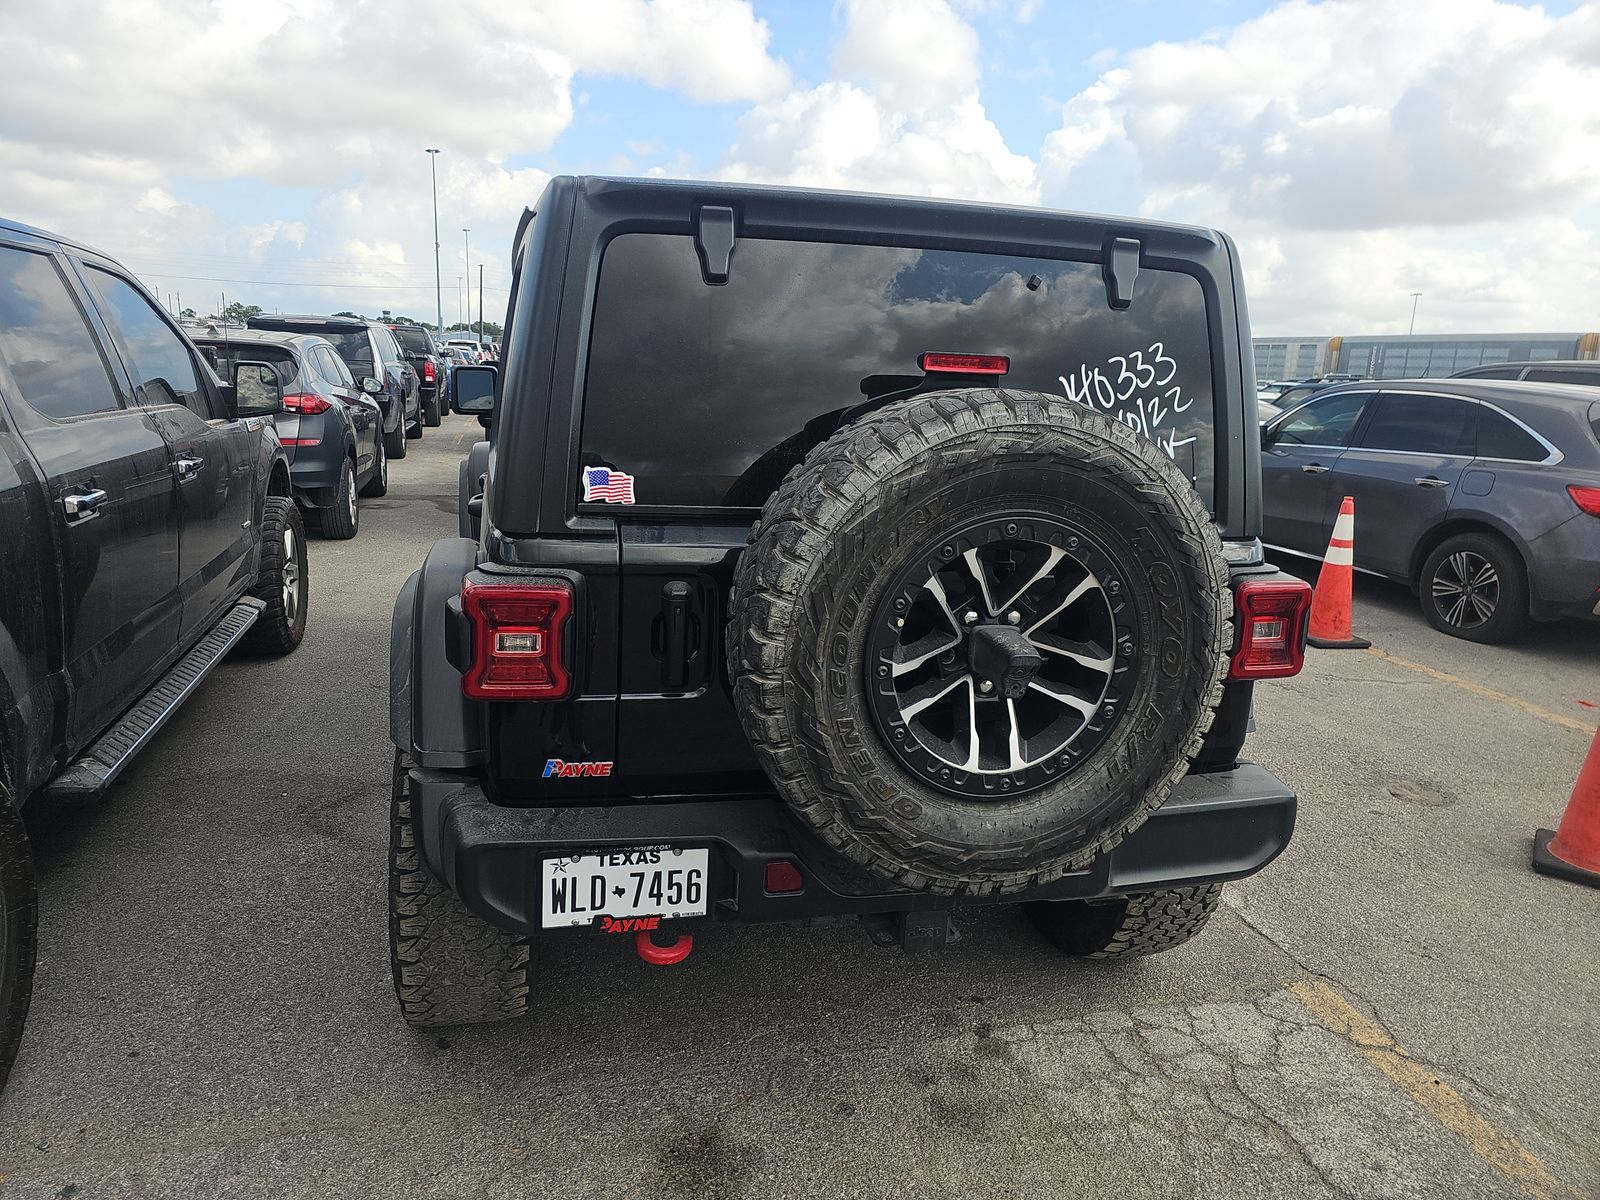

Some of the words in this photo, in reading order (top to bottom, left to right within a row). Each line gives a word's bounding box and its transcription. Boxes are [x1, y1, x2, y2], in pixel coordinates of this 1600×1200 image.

[541, 758, 614, 778] PAYNE
[836, 716, 924, 821] OPEN
[596, 849, 662, 868] TEXAS
[551, 874, 607, 915] WLD
[629, 869, 703, 909] 7456
[599, 916, 661, 934] PAYNE
